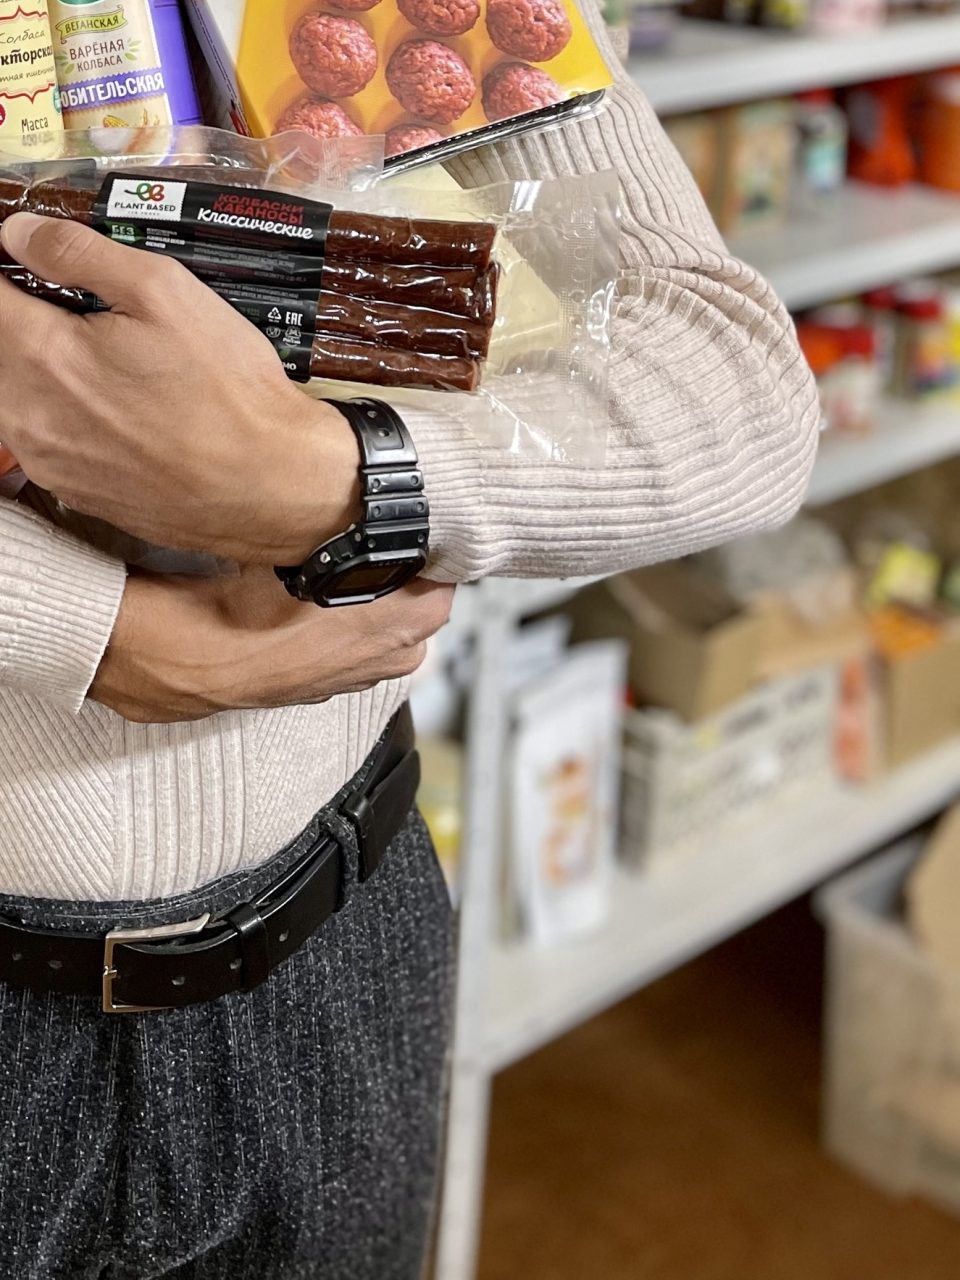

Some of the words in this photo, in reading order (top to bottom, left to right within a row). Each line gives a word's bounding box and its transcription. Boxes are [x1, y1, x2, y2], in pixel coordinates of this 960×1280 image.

[65, 15, 119, 33] ВЕГАНСКАЯ
[69, 39, 125, 61] ВАРЁНАЯ
[77, 54, 123, 72] КОЛБАСА
[60, 72, 165, 108] ЮБИТЕЛЬСКАЯ
[21, 117, 49, 133] Масса
[114, 202, 145, 210] PLANT
[146, 204, 177, 212] BASED
[218, 193, 305, 213] КОЛБАСКИ
[213, 201, 305, 225] КАБАНОСЫ
[111, 225, 135, 236] БЕЗ
[197, 207, 314, 240] Классические
[285, 311, 304, 326] EAC
